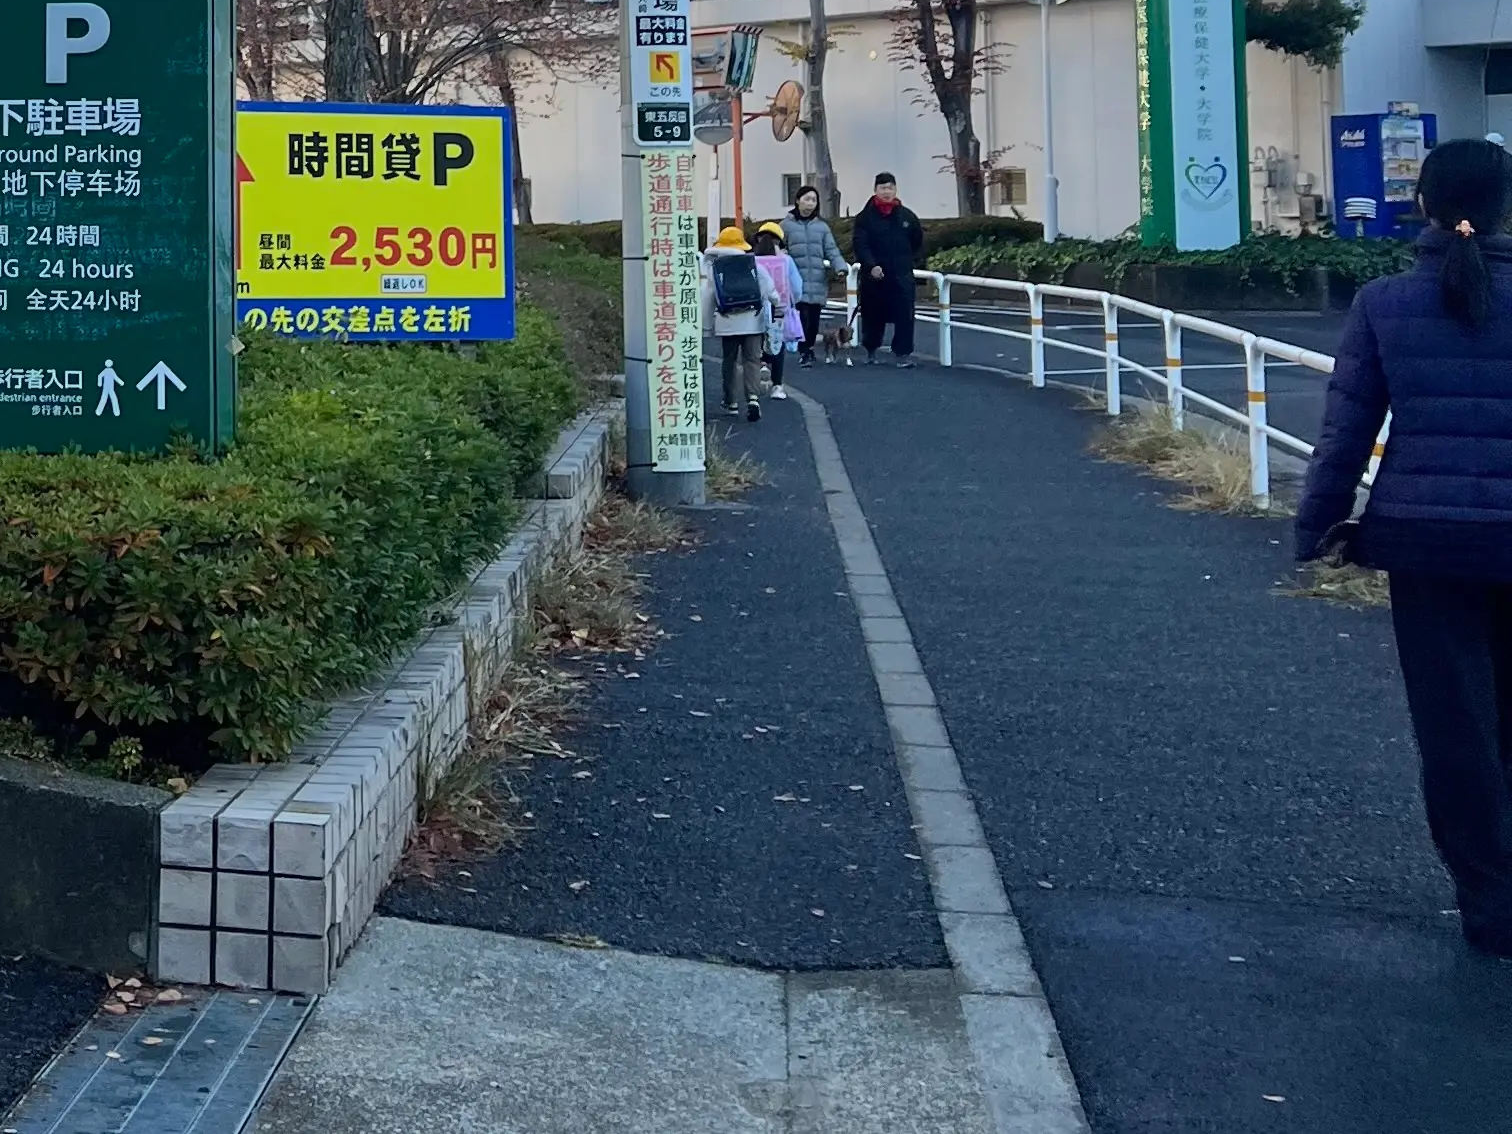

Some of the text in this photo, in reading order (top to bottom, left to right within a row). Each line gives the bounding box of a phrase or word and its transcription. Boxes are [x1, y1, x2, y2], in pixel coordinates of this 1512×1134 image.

[45, 3, 111, 84] P
[639, 32, 685, 45] 有ります
[649, 87, 682, 98] この先
[653, 125, 682, 138] 5-9
[65, 144, 142, 167] Parking
[287, 130, 475, 187] 時間貸P
[1, 170, 142, 198] 地下停车场
[259, 233, 291, 251] 昼間
[330, 226, 497, 273] 2,530円
[38, 259, 66, 279] 24
[72, 257, 135, 280] hours
[259, 253, 326, 271] 最大料金
[26, 288, 142, 313] 全天24小时
[647, 153, 681, 429] 歩道通行時は車道寄りを徐行
[39, 393, 83, 403] entrance
